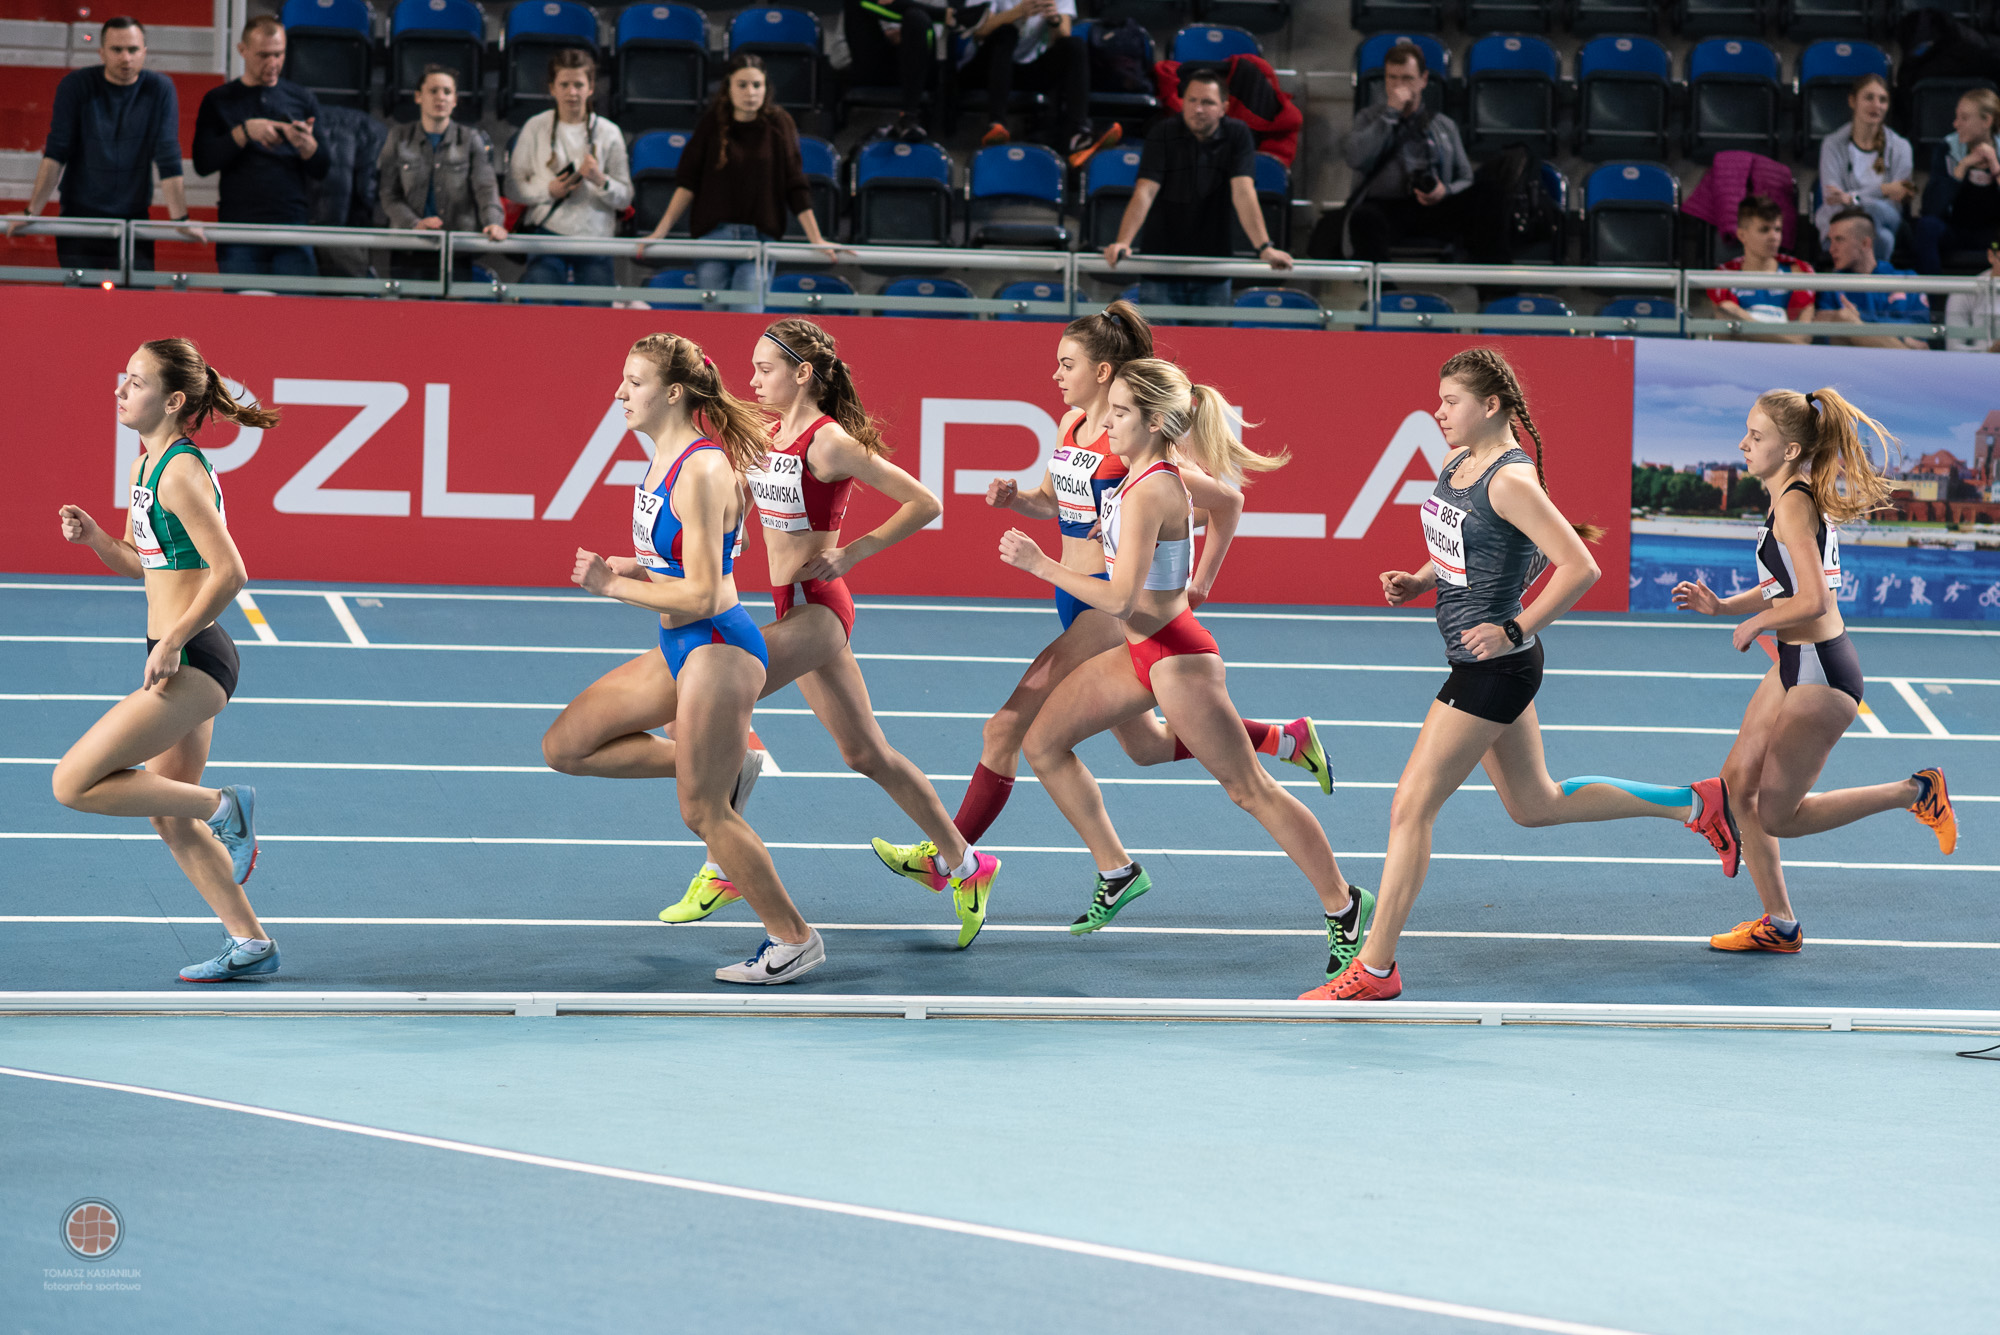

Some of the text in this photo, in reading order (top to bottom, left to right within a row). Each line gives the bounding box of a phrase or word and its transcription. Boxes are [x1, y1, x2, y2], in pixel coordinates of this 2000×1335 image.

[115, 372, 655, 520] PZLA
[773, 456, 798, 475] 692
[920, 398, 1450, 540] PLA
[1072, 452, 1097, 469] 890
[1052, 472, 1089, 497] YROŚLAK
[775, 520, 788, 529] 2019
[1069, 510, 1082, 520] 2019
[1440, 506, 1460, 528] 885
